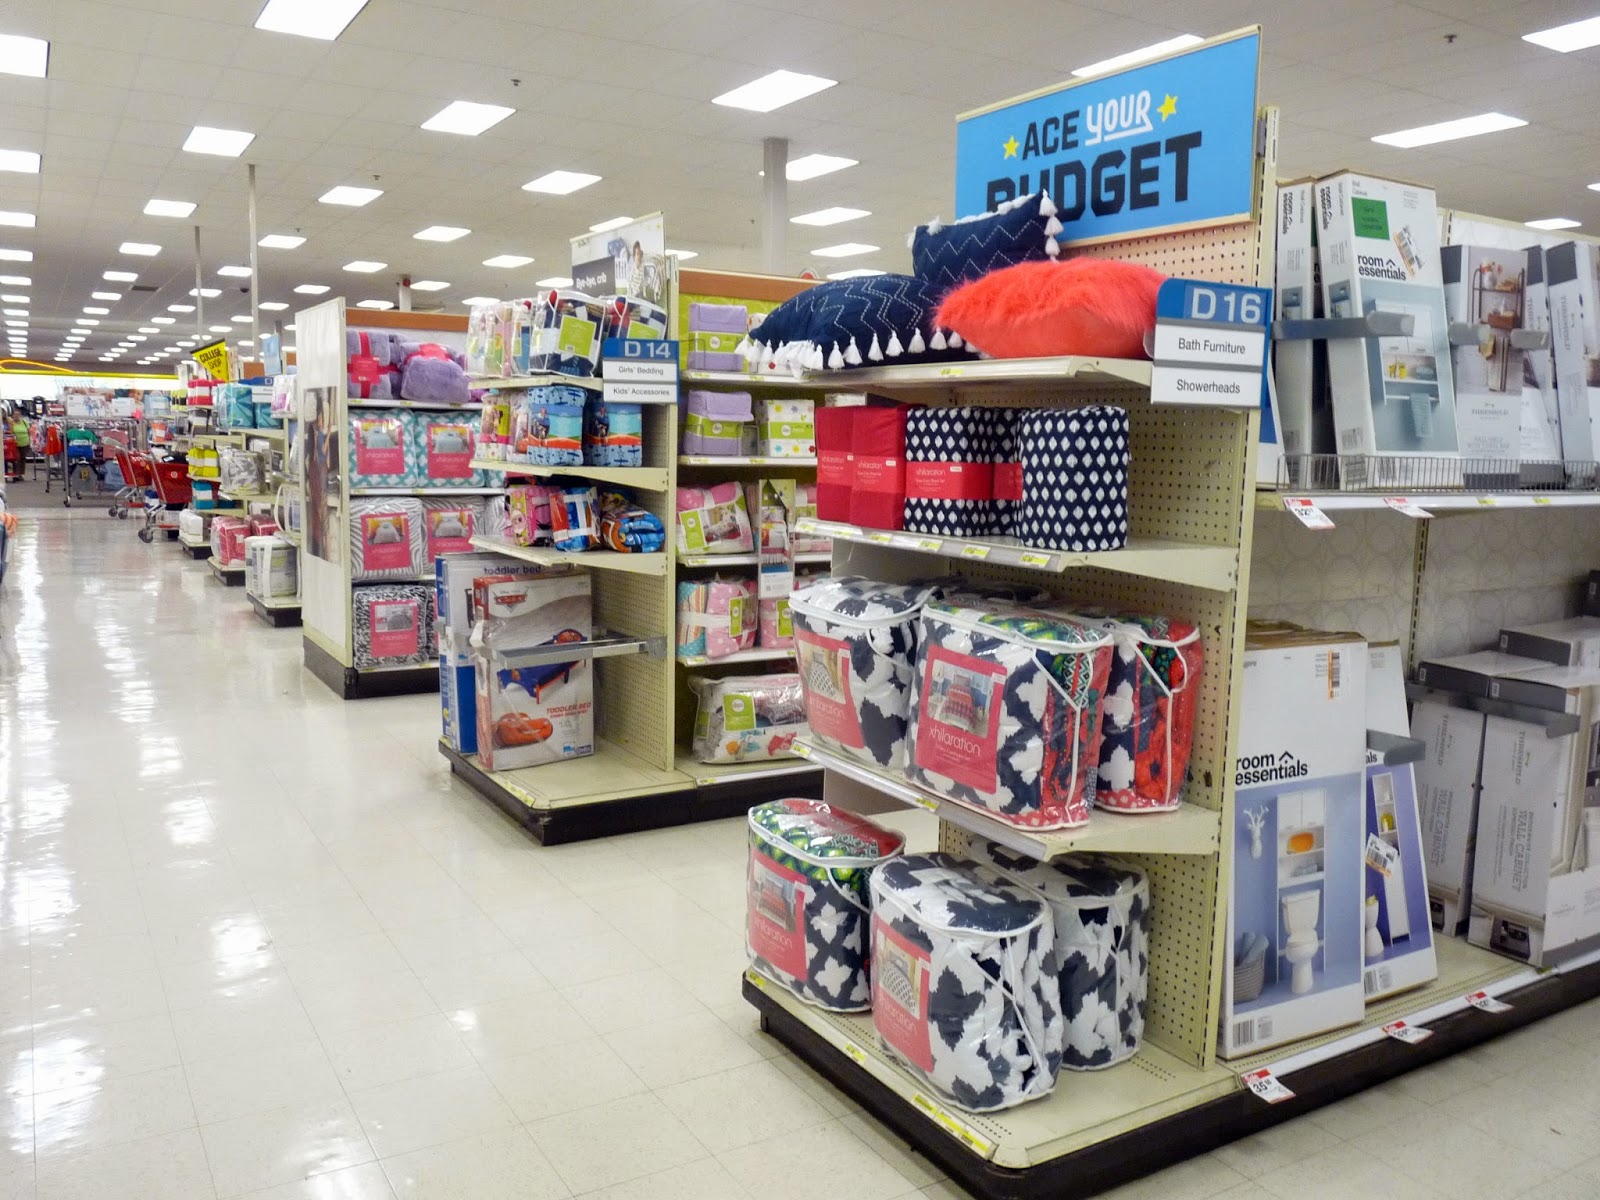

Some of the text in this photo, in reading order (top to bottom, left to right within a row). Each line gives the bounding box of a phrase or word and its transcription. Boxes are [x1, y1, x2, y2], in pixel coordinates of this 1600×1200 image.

[1022, 89, 1154, 161] ACE YOUR
[1357, 254, 1384, 268] room
[1358, 265, 1407, 281] essentials
[1191, 287, 1262, 324] D 16
[625, 340, 671, 358] D 14
[1178, 337, 1246, 354] Bath Furniture
[199, 347, 222, 364] COLLEGE
[208, 357, 222, 370] SHOP
[637, 367, 664, 375] Bedding
[613, 387, 670, 396] Kids' Accessories
[1176, 378, 1241, 394] Showerheads
[483, 564, 542, 576] toddler bed
[928, 724, 982, 758] xhilaration
[1236, 752, 1275, 772] room
[1235, 759, 1309, 786] essentials
[1511, 809, 1528, 894] WALL CABINET
